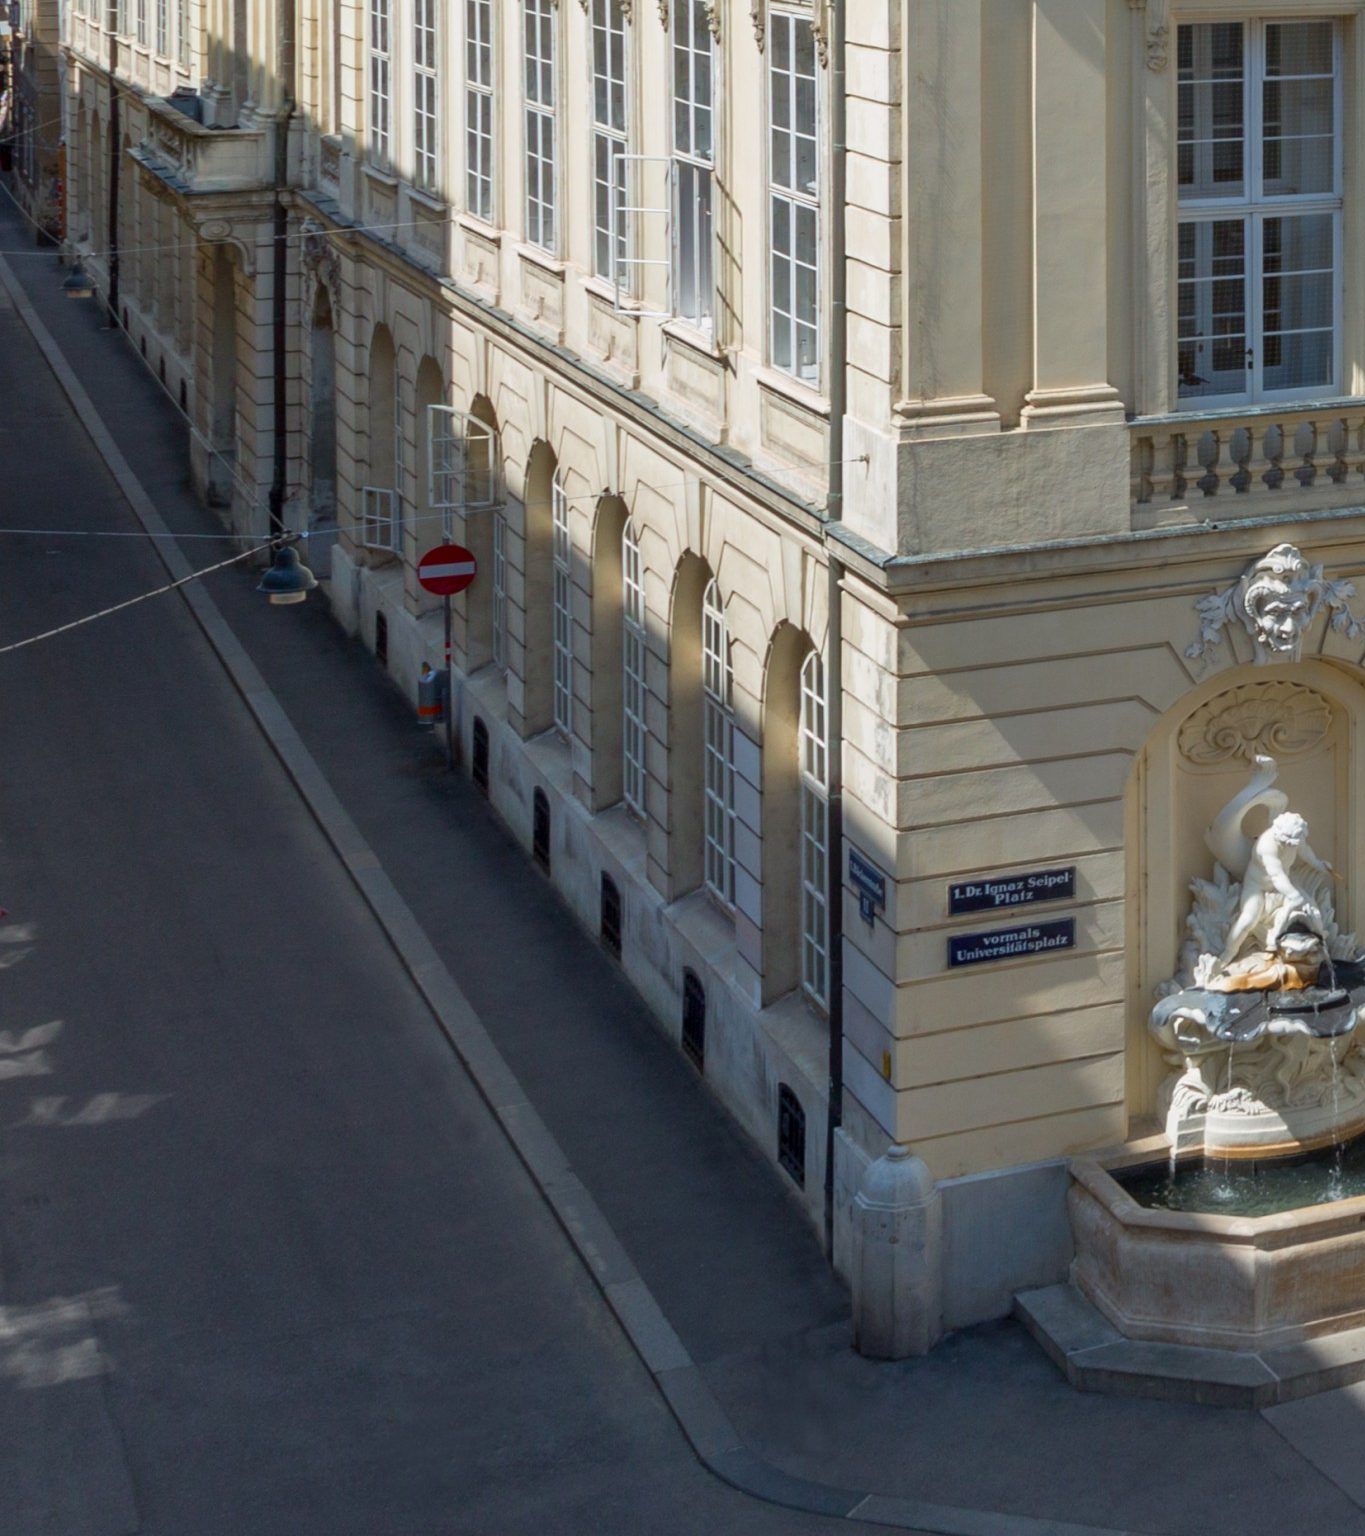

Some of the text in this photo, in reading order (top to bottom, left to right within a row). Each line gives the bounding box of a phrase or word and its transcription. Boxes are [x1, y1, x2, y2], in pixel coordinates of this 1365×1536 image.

[985, 880, 1024, 896] Ignaz
[994, 891, 1034, 905] Platz
[983, 927, 1040, 945] vormals
[956, 934, 1069, 962] Universitätsplatz
